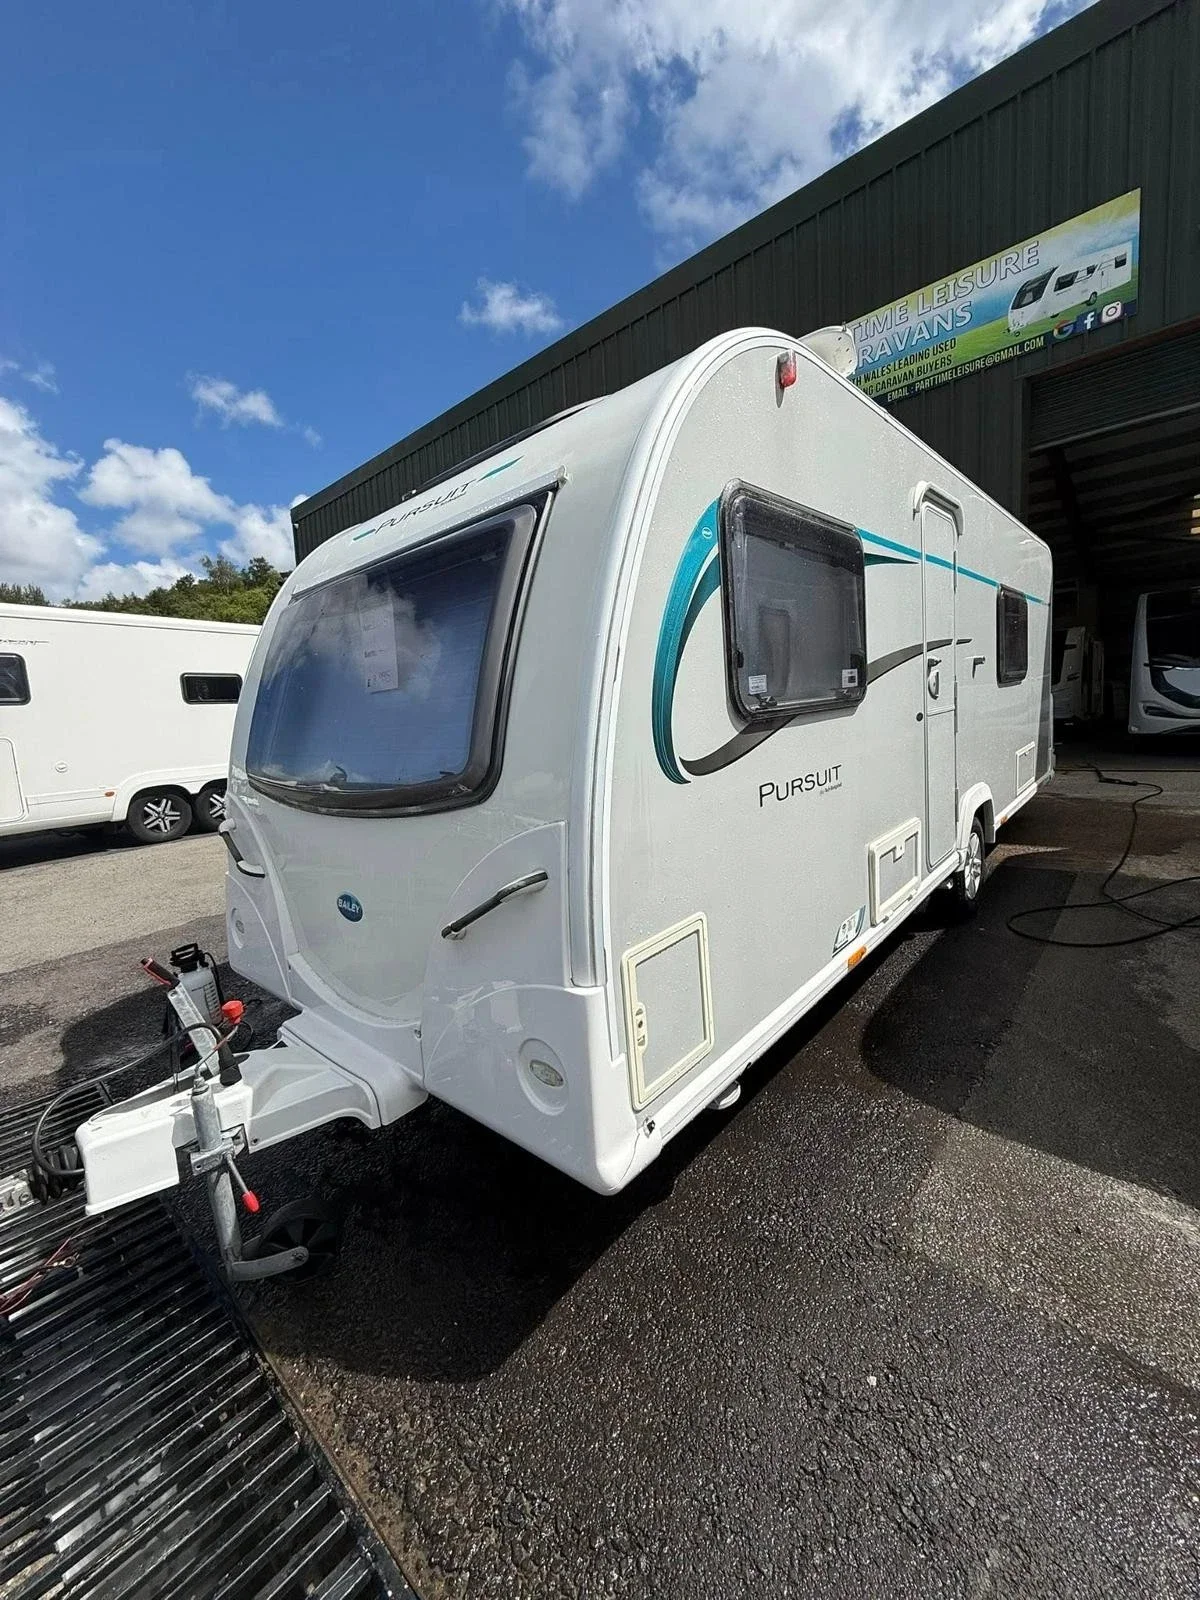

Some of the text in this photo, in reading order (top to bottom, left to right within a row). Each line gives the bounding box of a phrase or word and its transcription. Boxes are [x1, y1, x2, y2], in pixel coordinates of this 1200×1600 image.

[850, 241, 1040, 345] TIME LEISURE
[857, 301, 972, 369] RAVANS
[863, 363, 892, 384] WALES
[893, 349, 931, 371] LEADING
[932, 337, 957, 356] USED
[875, 368, 915, 391] CARAVAN
[916, 354, 953, 377] BUYERS
[887, 386, 909, 402] EMAIL
[915, 336, 1044, 392] PARTTIMELEISURE@GMAIL.COM
[375, 479, 476, 534] PURSUIT
[759, 764, 842, 808] PURSUIT
